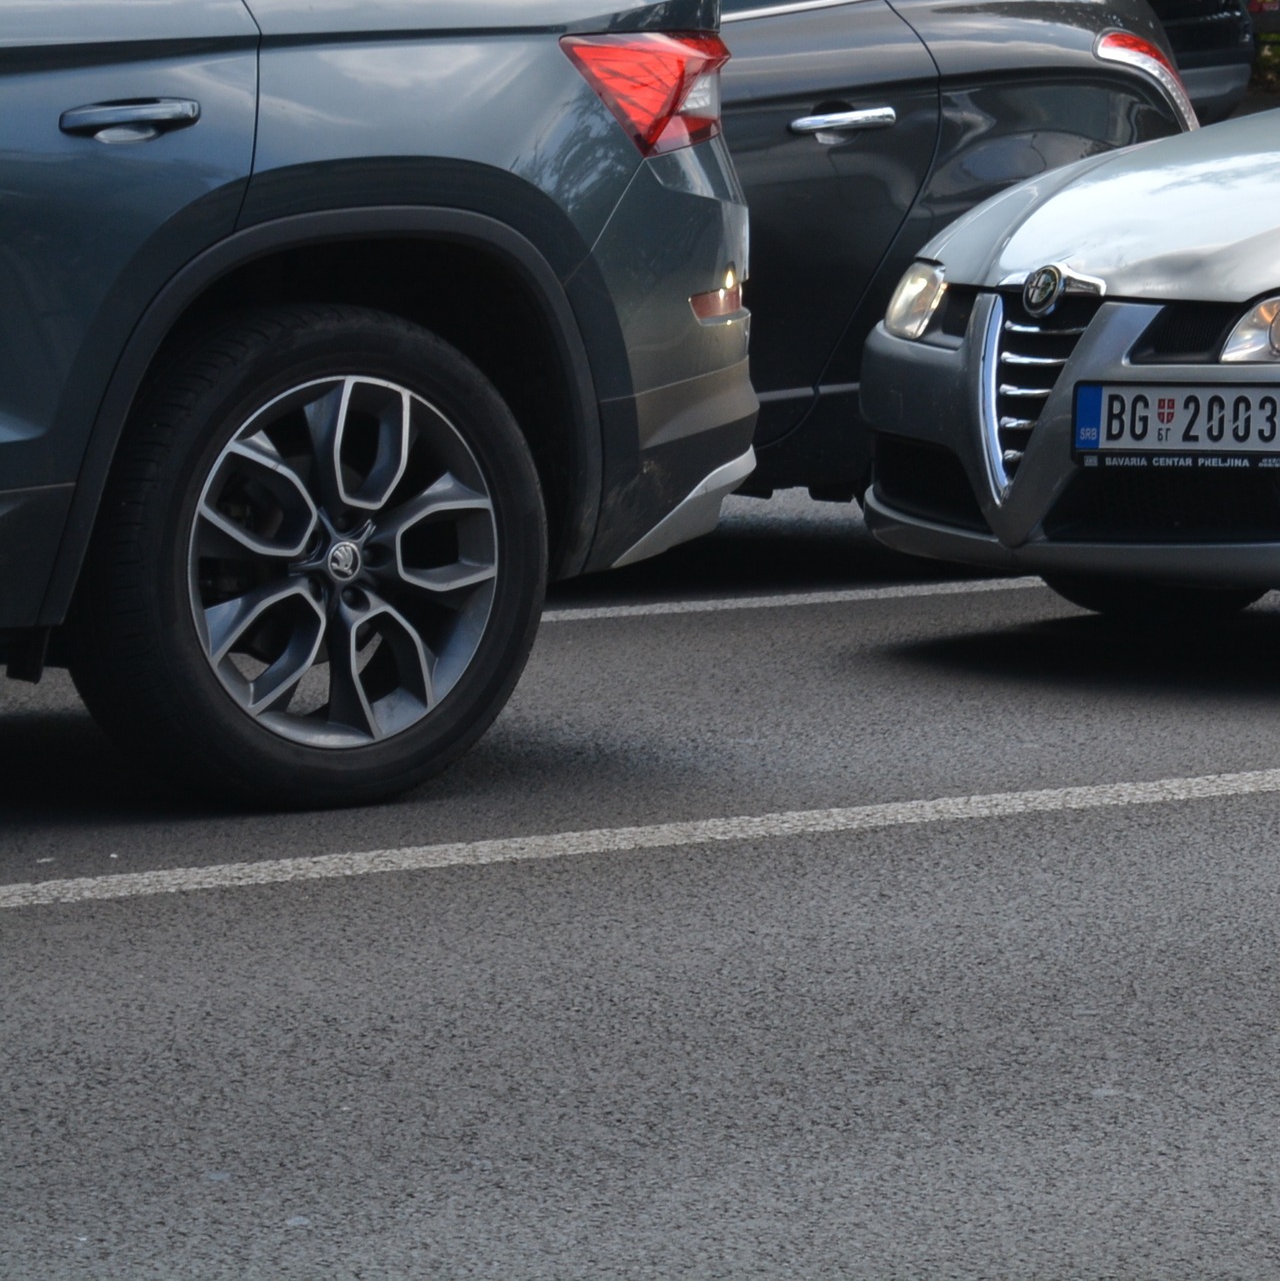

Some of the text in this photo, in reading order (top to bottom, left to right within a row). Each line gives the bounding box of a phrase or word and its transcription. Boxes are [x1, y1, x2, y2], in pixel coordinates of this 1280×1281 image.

[1105, 394, 1150, 441] BG
[1080, 428, 1098, 441] SRB
[1105, 457, 1147, 468] BAVARIA
[1152, 457, 1192, 468] CENTAR
[1198, 458, 1250, 468] PRELJINA
